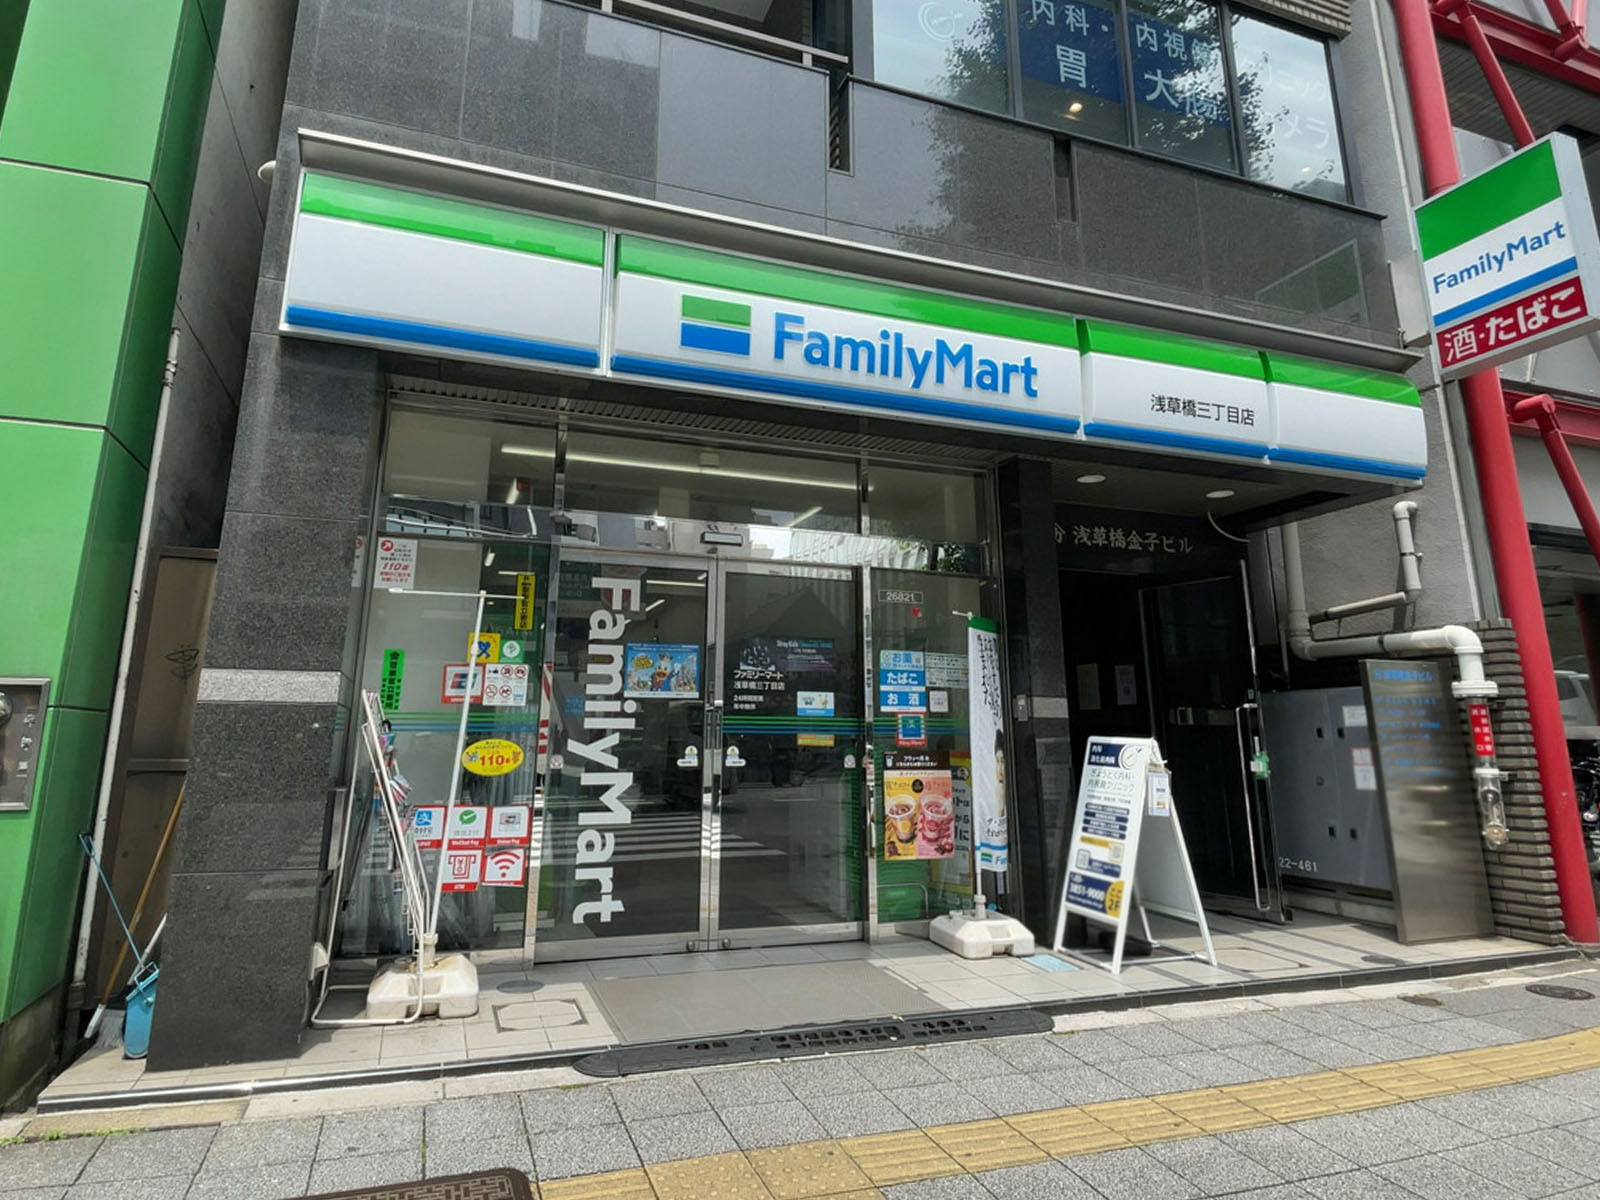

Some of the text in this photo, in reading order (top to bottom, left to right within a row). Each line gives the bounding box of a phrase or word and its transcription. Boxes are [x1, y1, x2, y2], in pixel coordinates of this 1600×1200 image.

[1432, 220, 1566, 294] FamilyMart
[1444, 286, 1581, 363] 酒・たばこ
[773, 312, 1039, 399] FamilyMart
[1150, 393, 1255, 426] 浅草橋三丁目店
[1072, 524, 1193, 553] 浅草橋金子ビル
[733, 669, 784, 680] ファミリーマート
[887, 671, 918, 684] たばこ
[568, 577, 640, 924] FamilyMart
